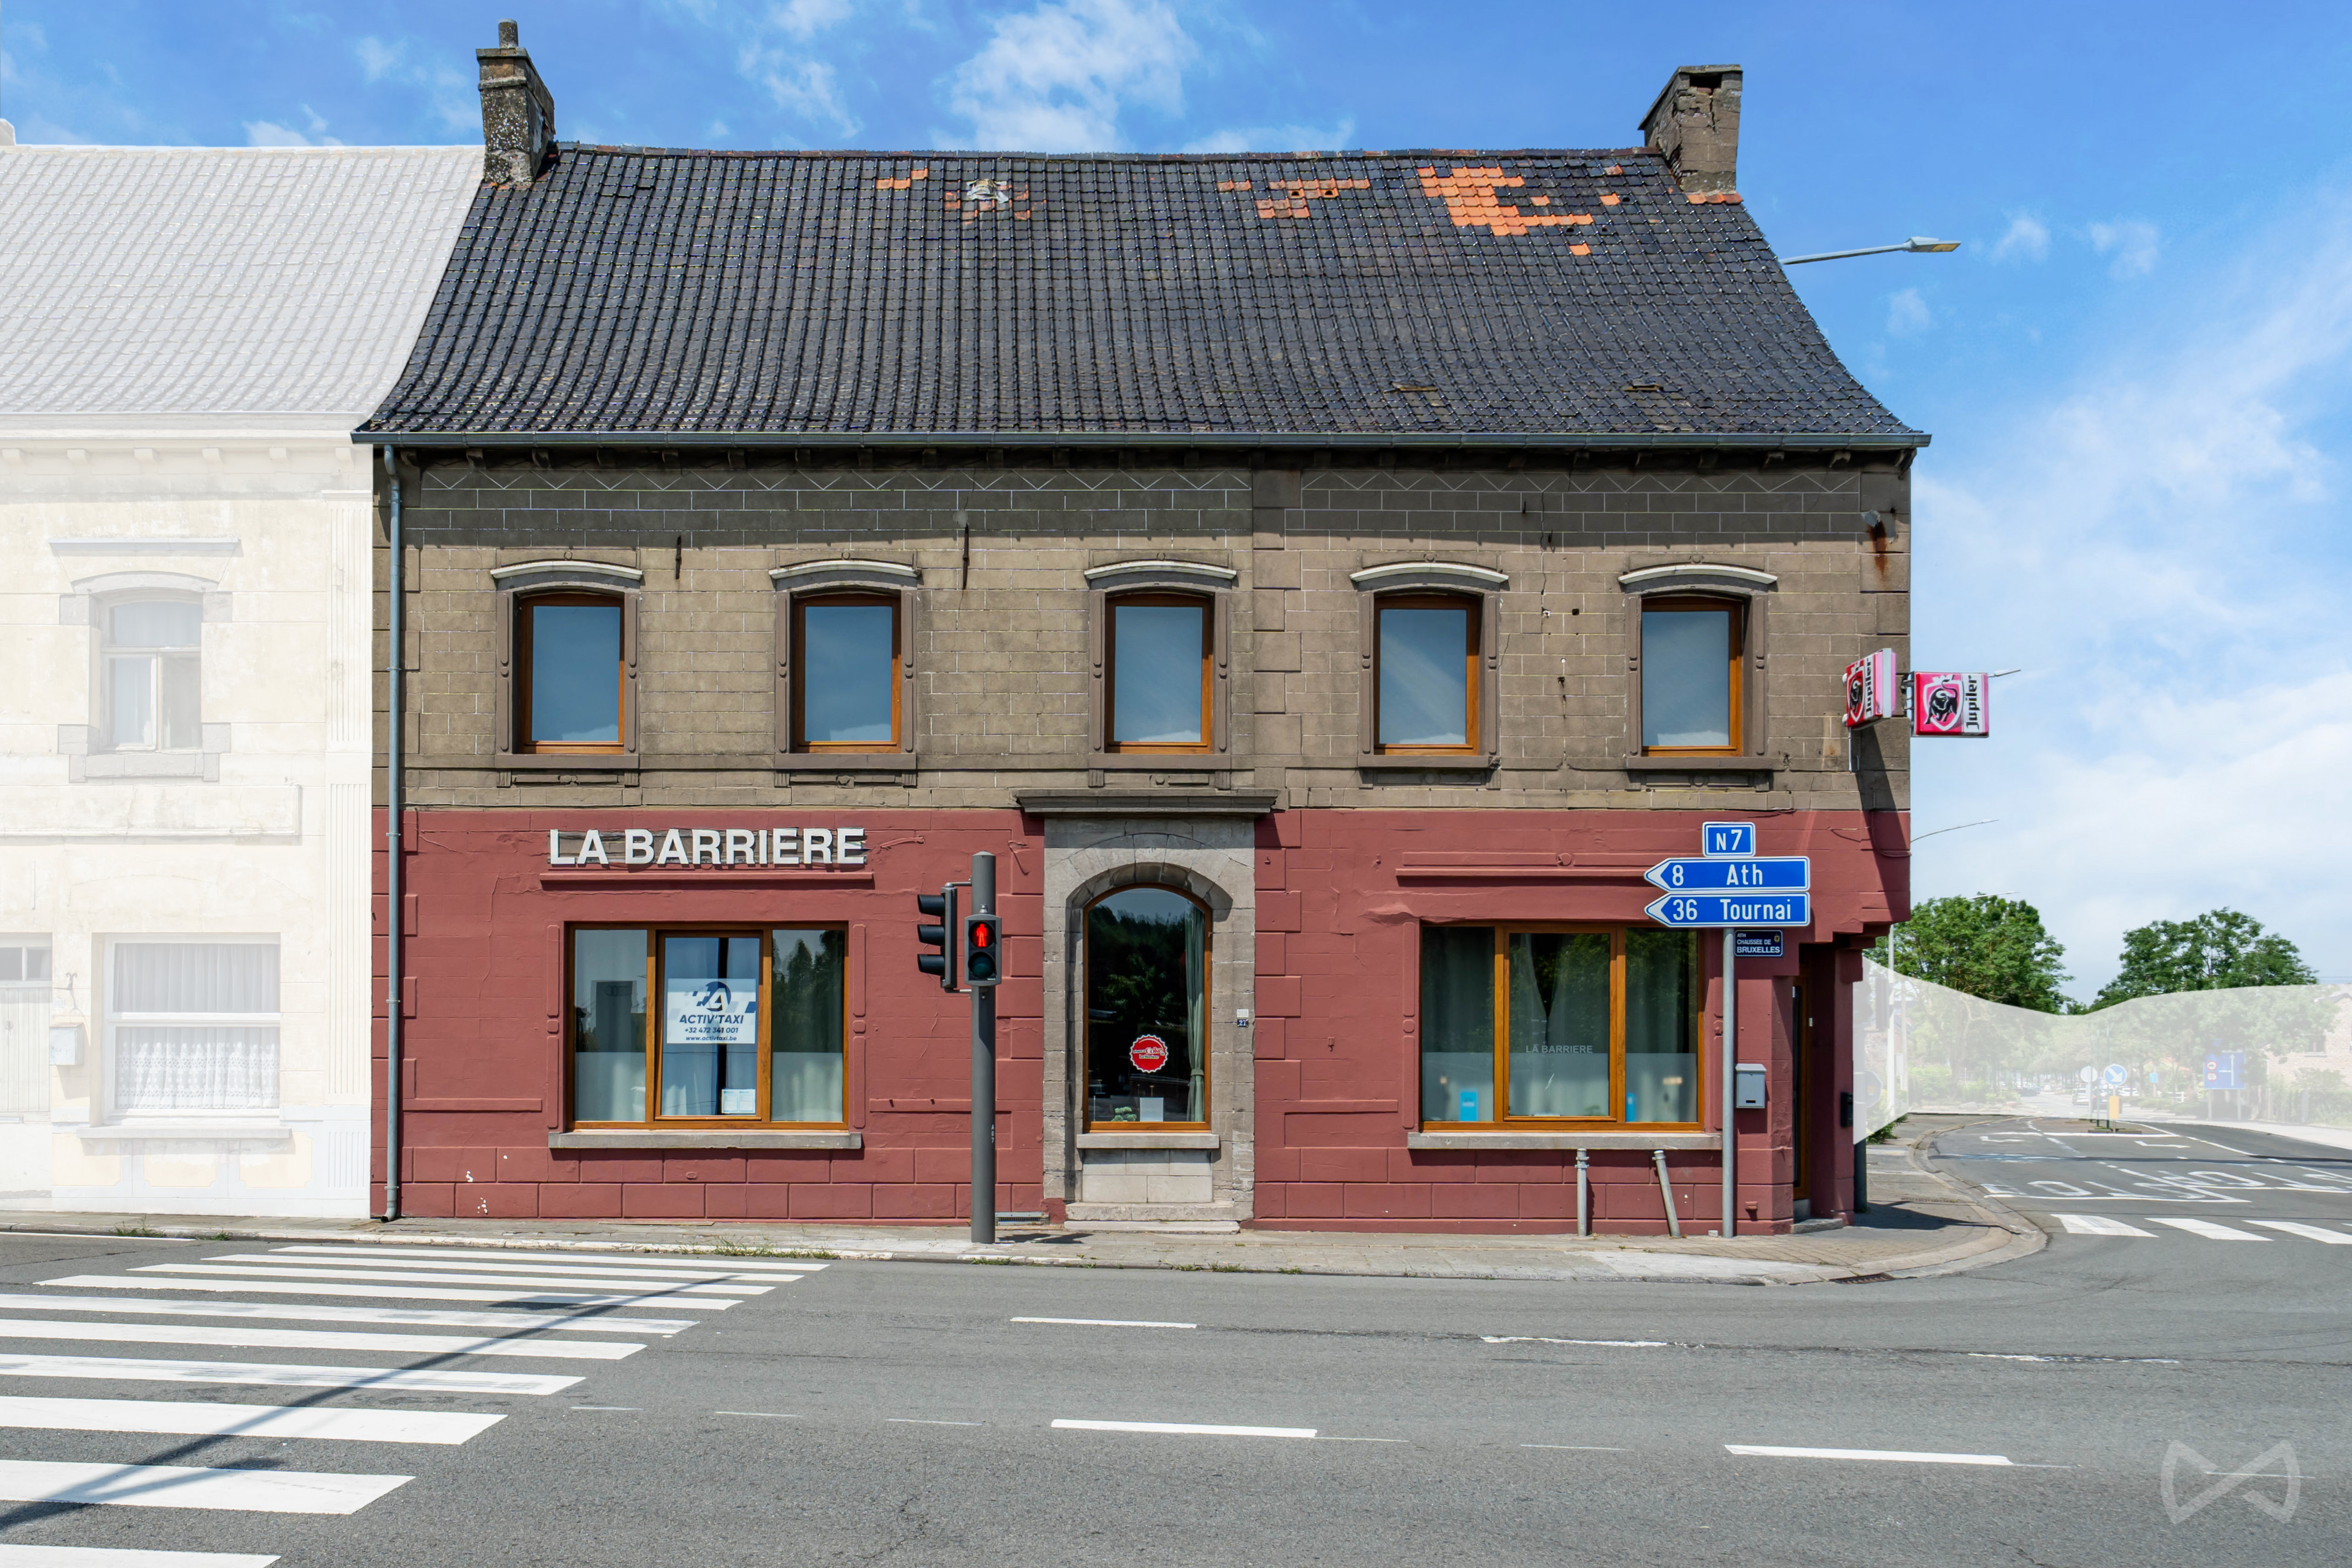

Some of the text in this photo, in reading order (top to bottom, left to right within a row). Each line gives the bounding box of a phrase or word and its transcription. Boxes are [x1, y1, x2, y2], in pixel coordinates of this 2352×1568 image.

[1966, 675, 1980, 730] Jupiler
[551, 828, 865, 865] LA BARRIERE
[1716, 829, 1742, 851] N7
[1672, 864, 1763, 886] 8 Ath
[1673, 899, 1791, 921] 36 Tournai
[679, 1014, 744, 1024] ACTIV'TAXI
